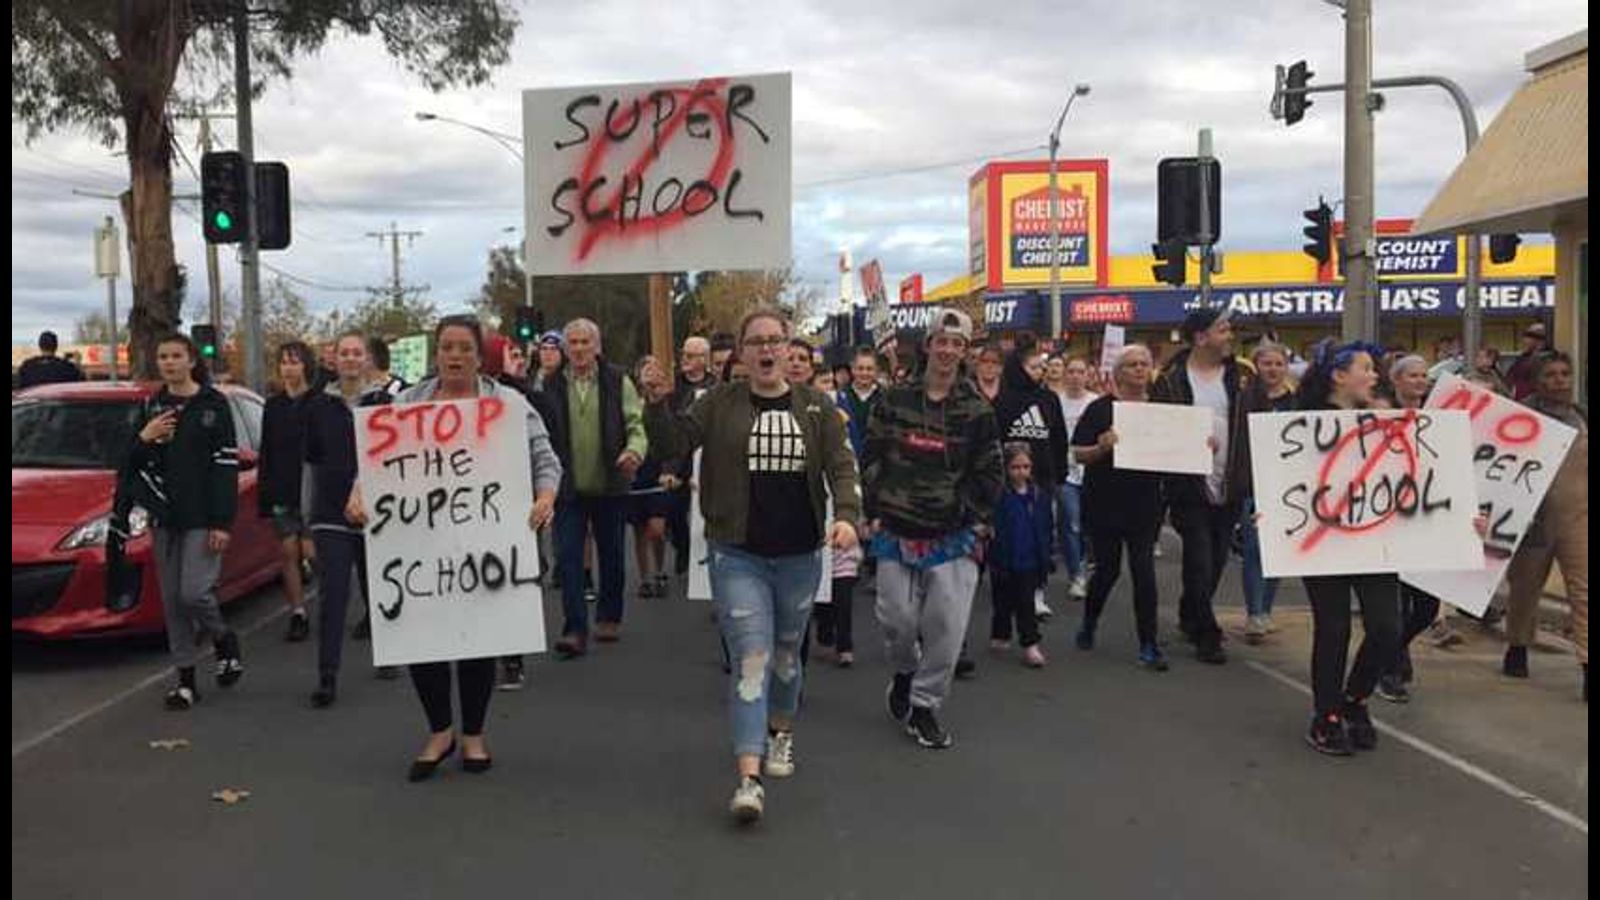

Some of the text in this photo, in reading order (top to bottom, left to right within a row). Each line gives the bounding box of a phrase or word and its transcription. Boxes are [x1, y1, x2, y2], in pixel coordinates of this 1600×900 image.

[554, 85, 770, 158] SUPER
[547, 169, 764, 237] SCHOOL
[1374, 256, 1442, 271] EMIST
[1378, 240, 1451, 255] COUNT
[367, 398, 505, 457] STOP
[1281, 411, 1439, 460] SUPER
[383, 449, 474, 482] THE
[1473, 443, 1543, 494] PER
[371, 482, 501, 535] SUPER
[1281, 468, 1451, 536] SCHOOL
[378, 544, 543, 621] SCHOOL
